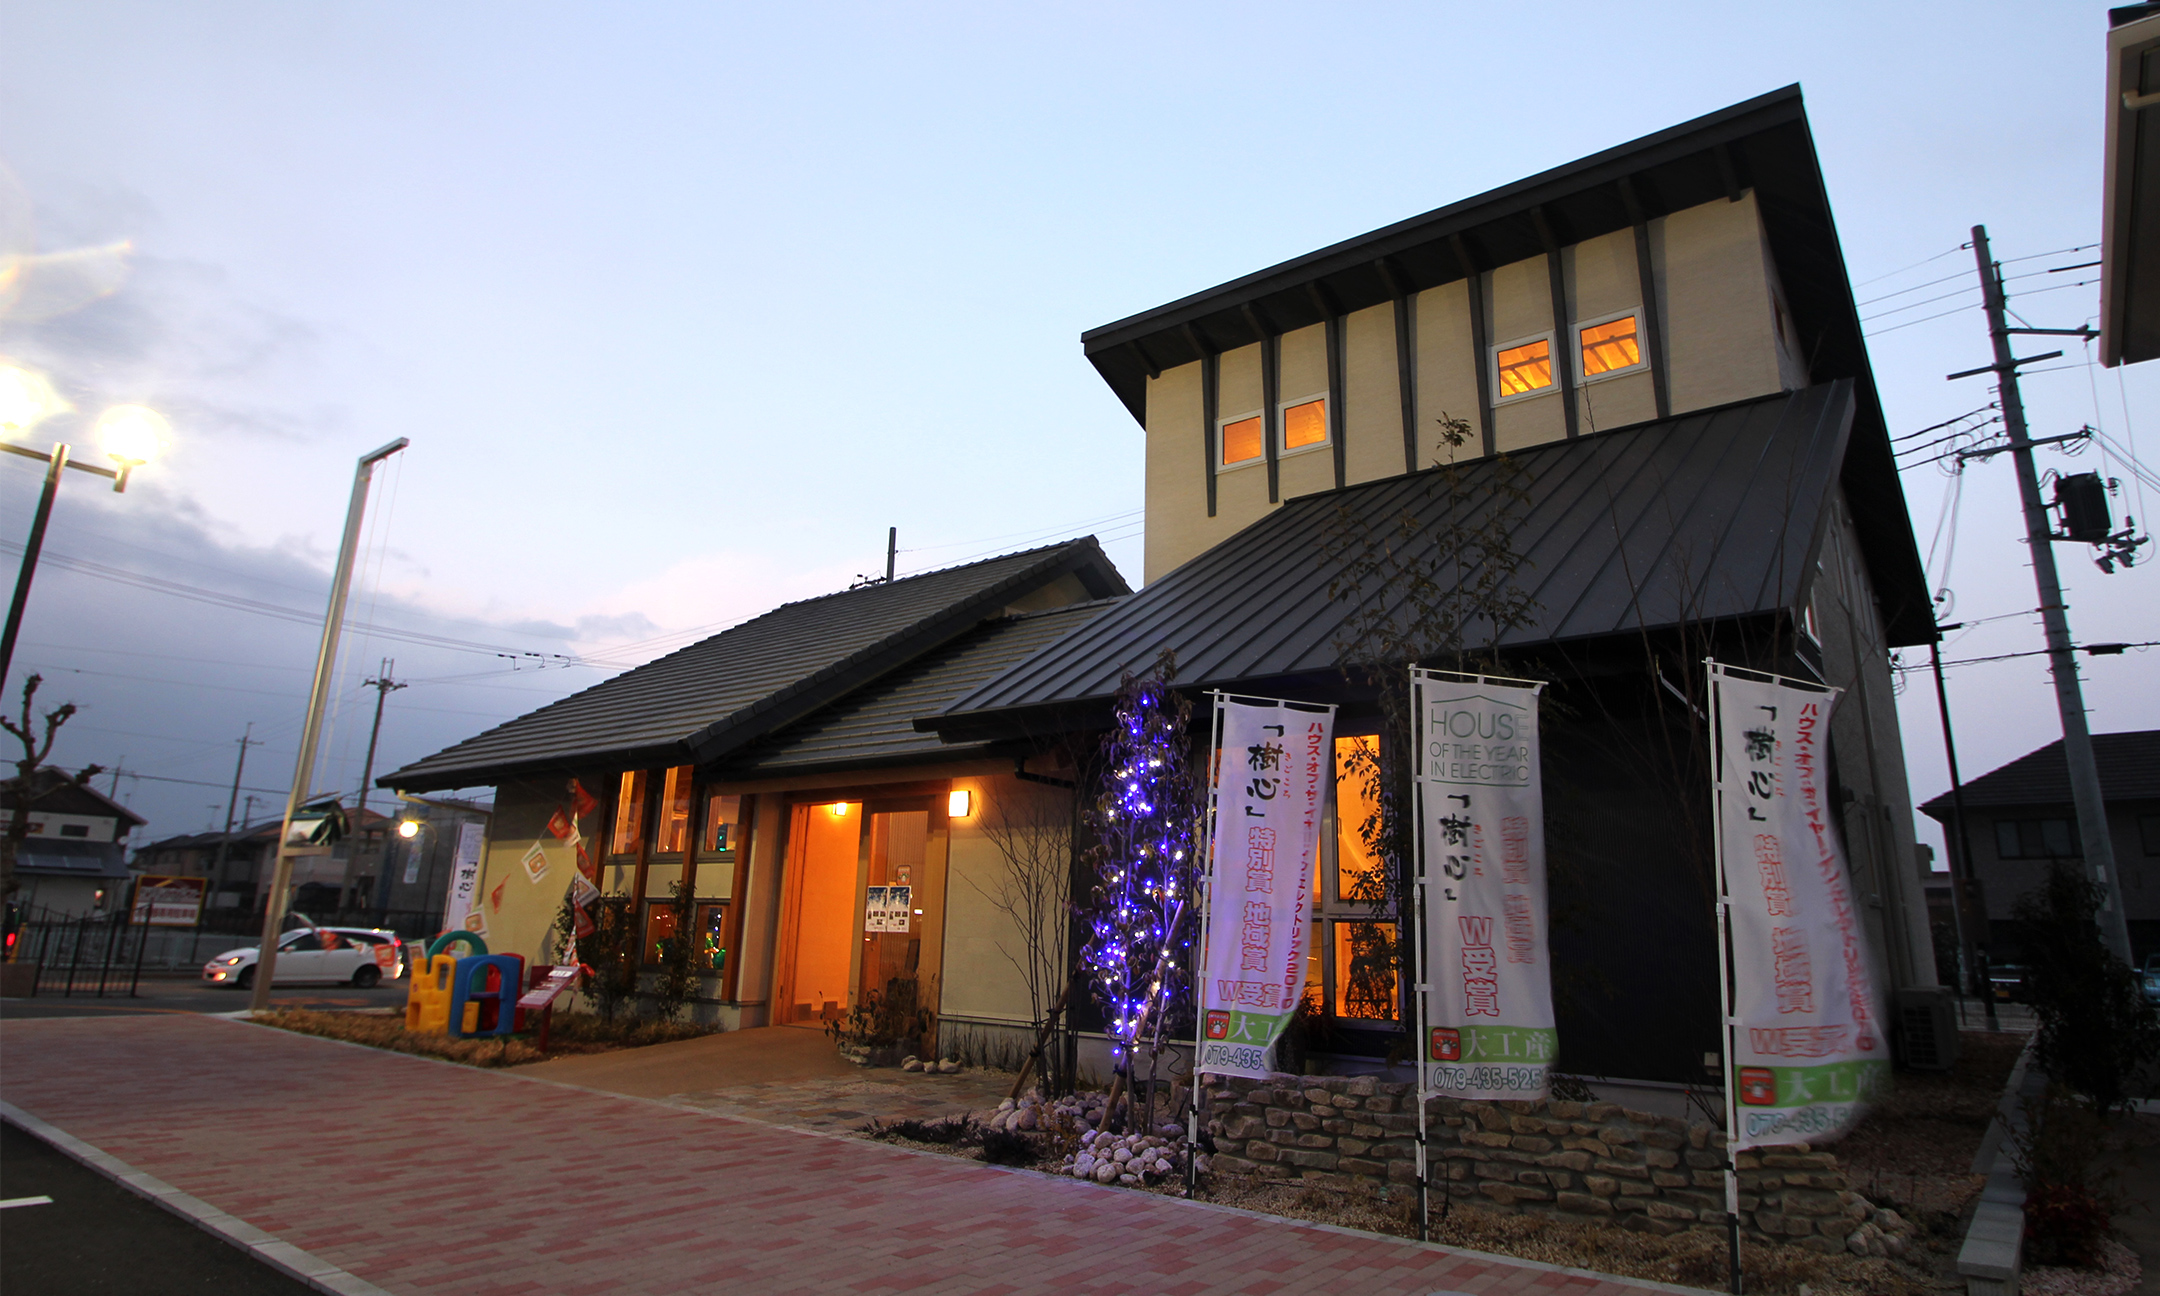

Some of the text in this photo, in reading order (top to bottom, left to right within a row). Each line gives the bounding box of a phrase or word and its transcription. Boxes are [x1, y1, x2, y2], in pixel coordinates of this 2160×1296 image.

[1431, 709, 1529, 741] HOUSE
[1430, 742, 1529, 762] OF THE YEAR
[1245, 724, 1284, 817] 「樹心」
[1431, 761, 1529, 781] IN ELECTRIC
[1241, 826, 1276, 972] 特別賞 地域賞
[1458, 915, 1500, 1017] W受賞
[1218, 980, 1283, 1009] W受賞
[1205, 1045, 1268, 1071] 079-435-
